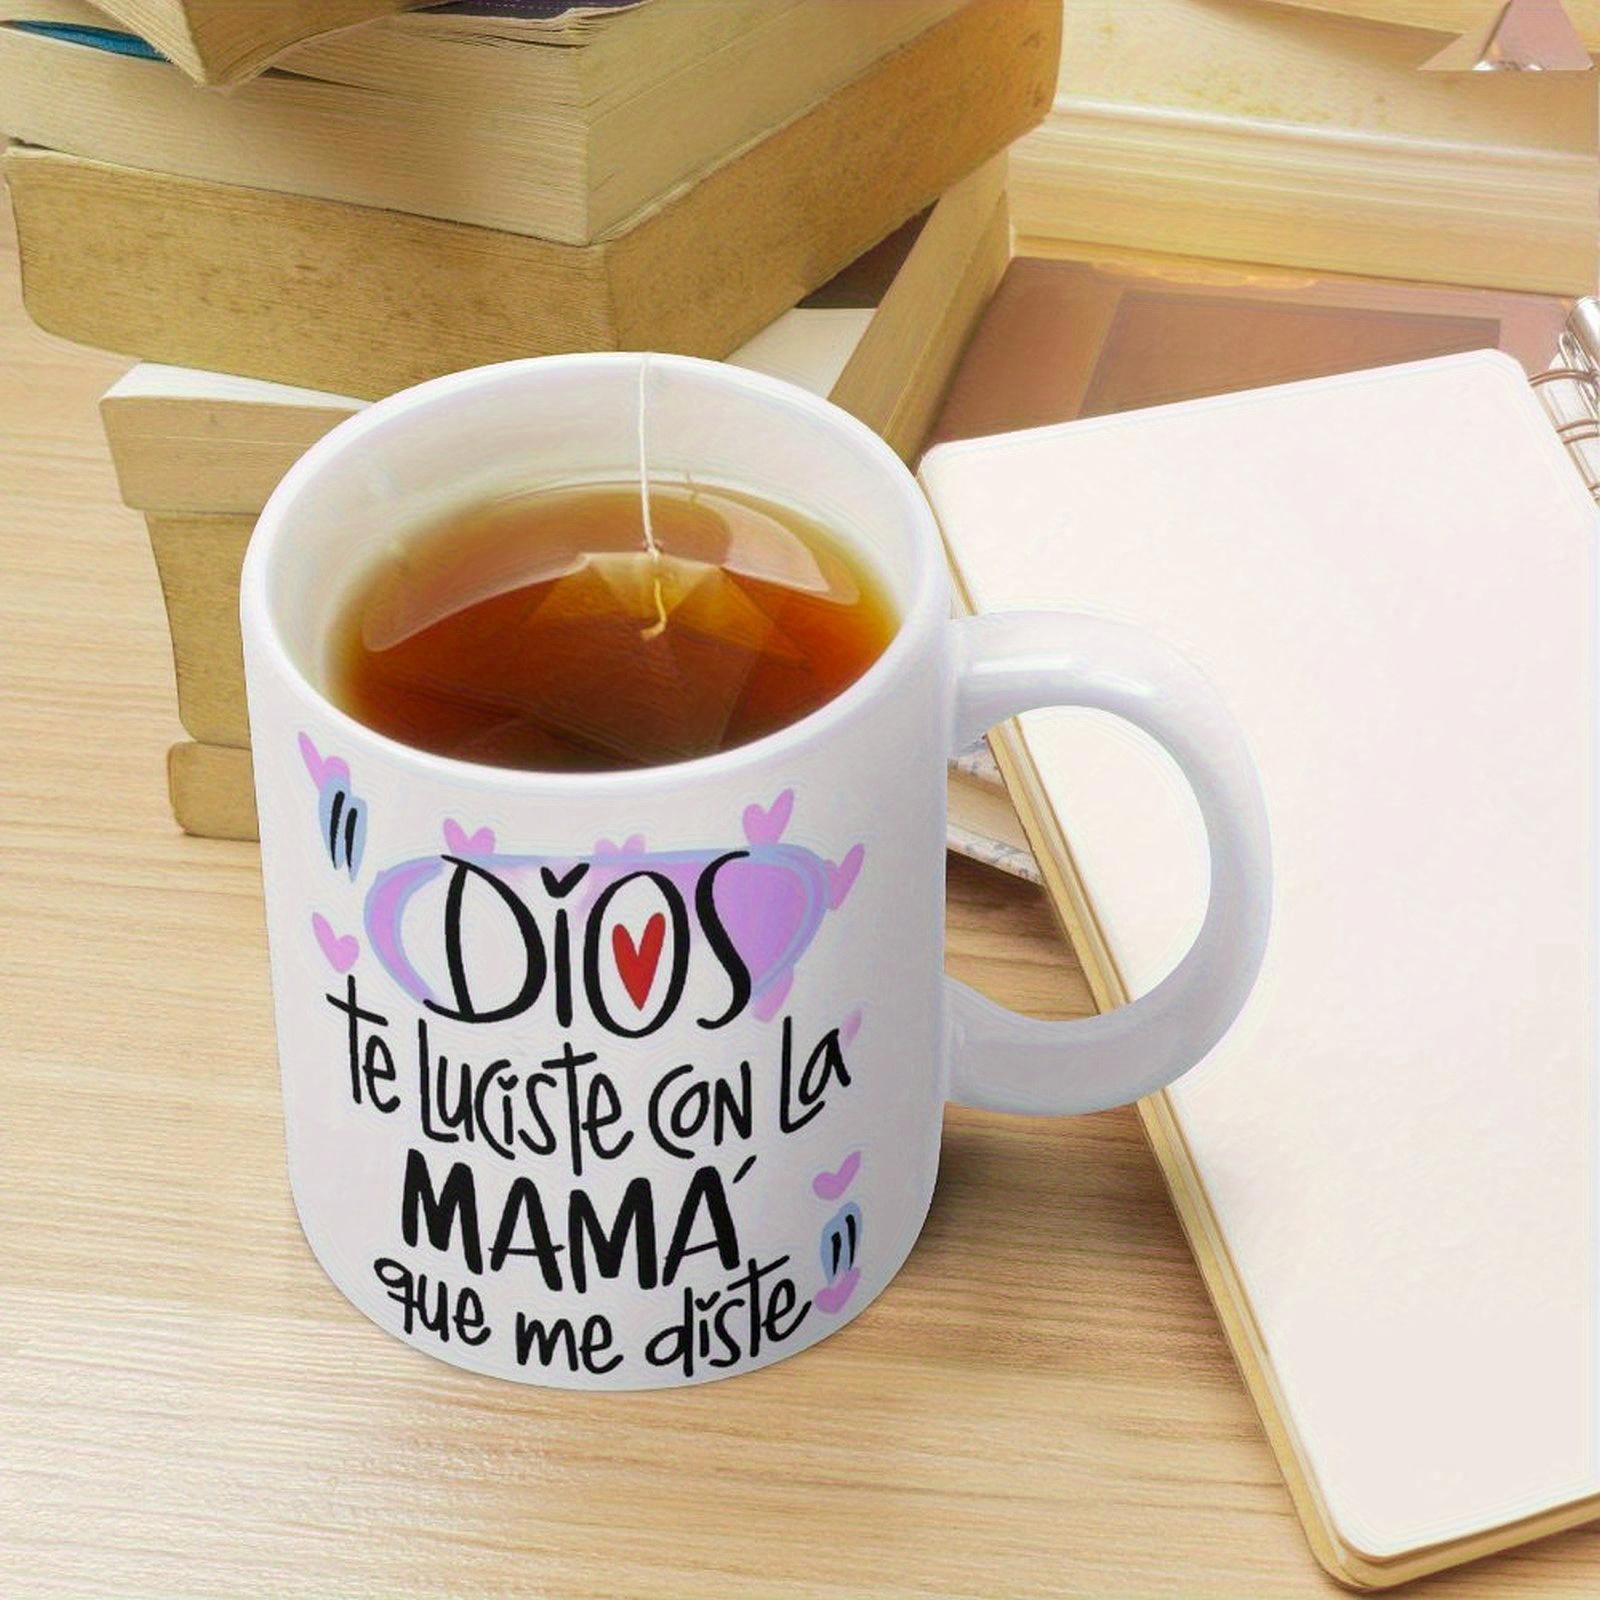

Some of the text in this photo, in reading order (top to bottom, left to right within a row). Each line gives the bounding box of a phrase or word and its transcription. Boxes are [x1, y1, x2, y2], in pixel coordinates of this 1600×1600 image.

[326, 974, 401, 1114] te
[401, 1148, 757, 1294] MAMÁ
[373, 1254, 813, 1378] que me diste
